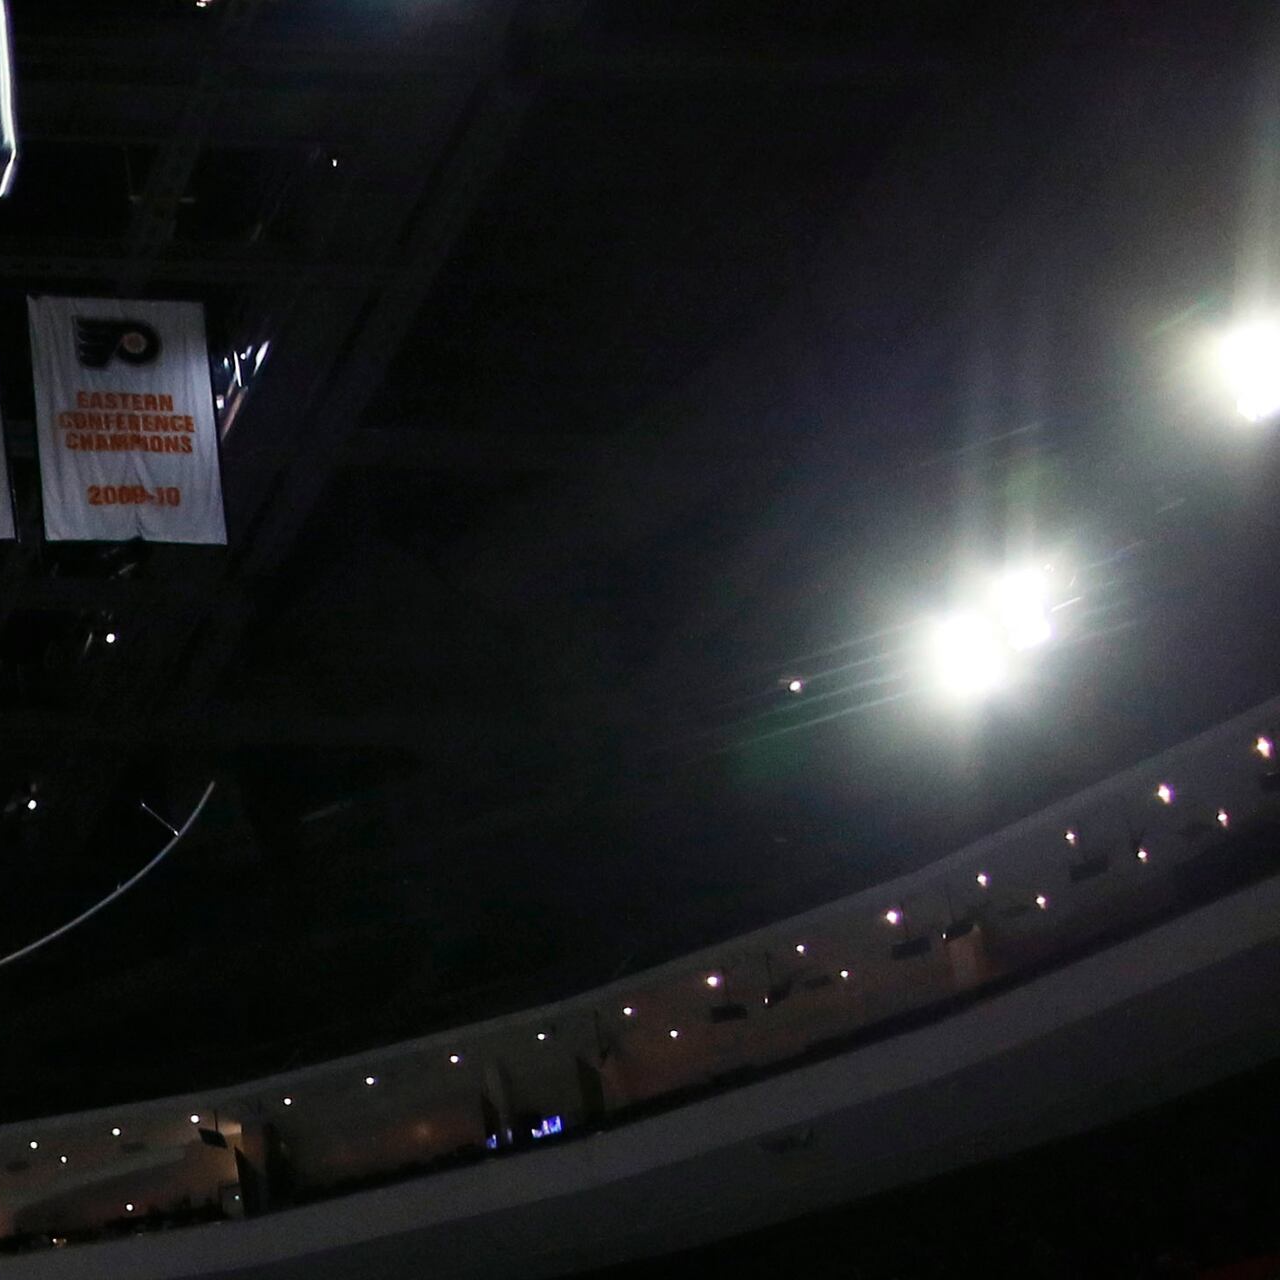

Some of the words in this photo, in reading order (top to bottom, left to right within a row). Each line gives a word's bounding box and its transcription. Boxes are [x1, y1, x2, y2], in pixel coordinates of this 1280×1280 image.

[75, 391, 173, 412] EASTERN
[57, 411, 196, 433] CONFERENCE
[65, 434, 193, 454] CHAMPIONS
